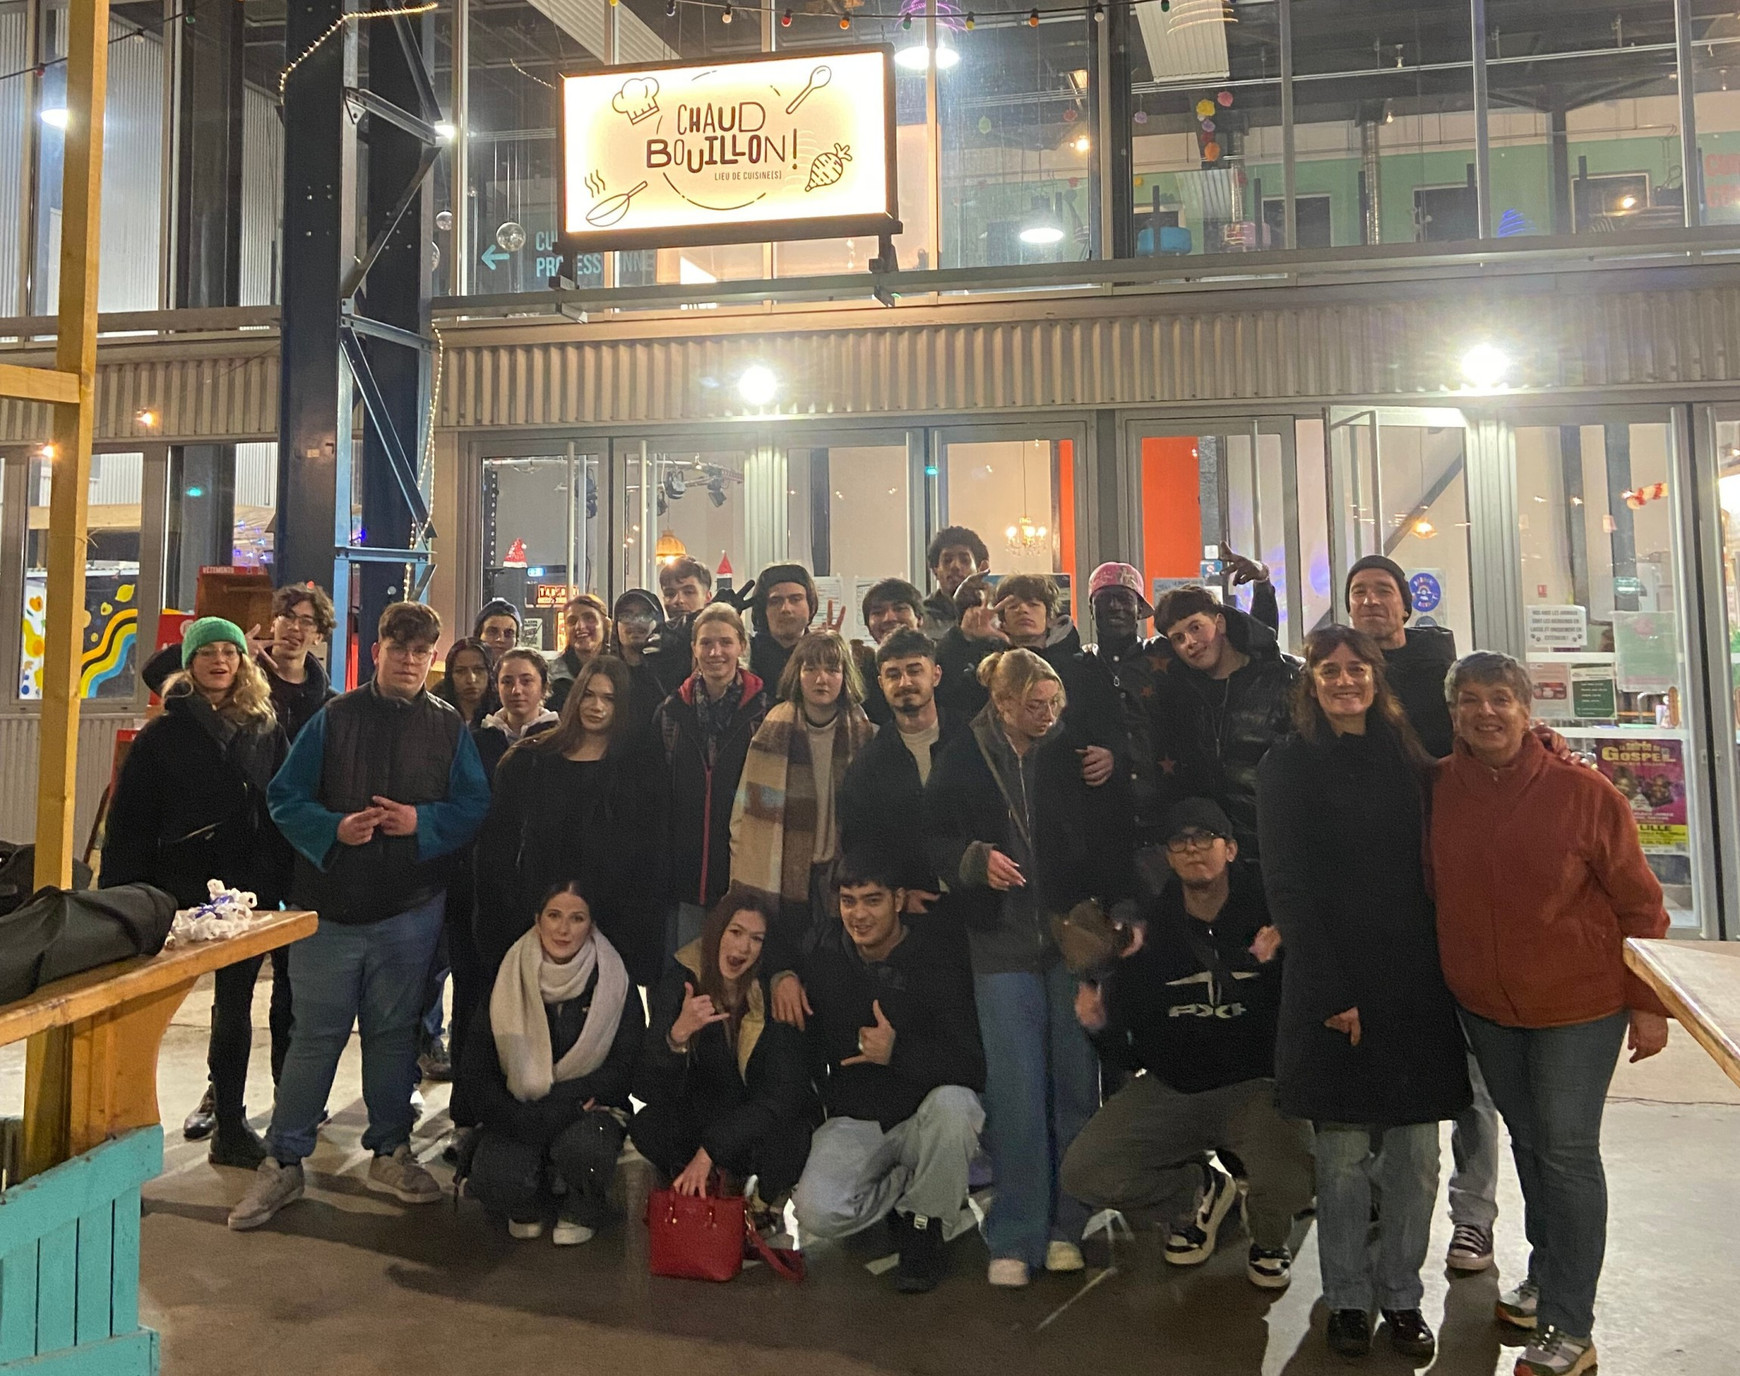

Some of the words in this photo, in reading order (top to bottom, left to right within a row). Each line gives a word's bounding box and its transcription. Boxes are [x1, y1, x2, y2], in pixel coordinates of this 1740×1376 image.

[677, 102, 766, 135] CHAUD
[646, 128, 798, 174] BOUILLON!
[714, 172, 730, 181] LIEU
[732, 171, 741, 180] DE
